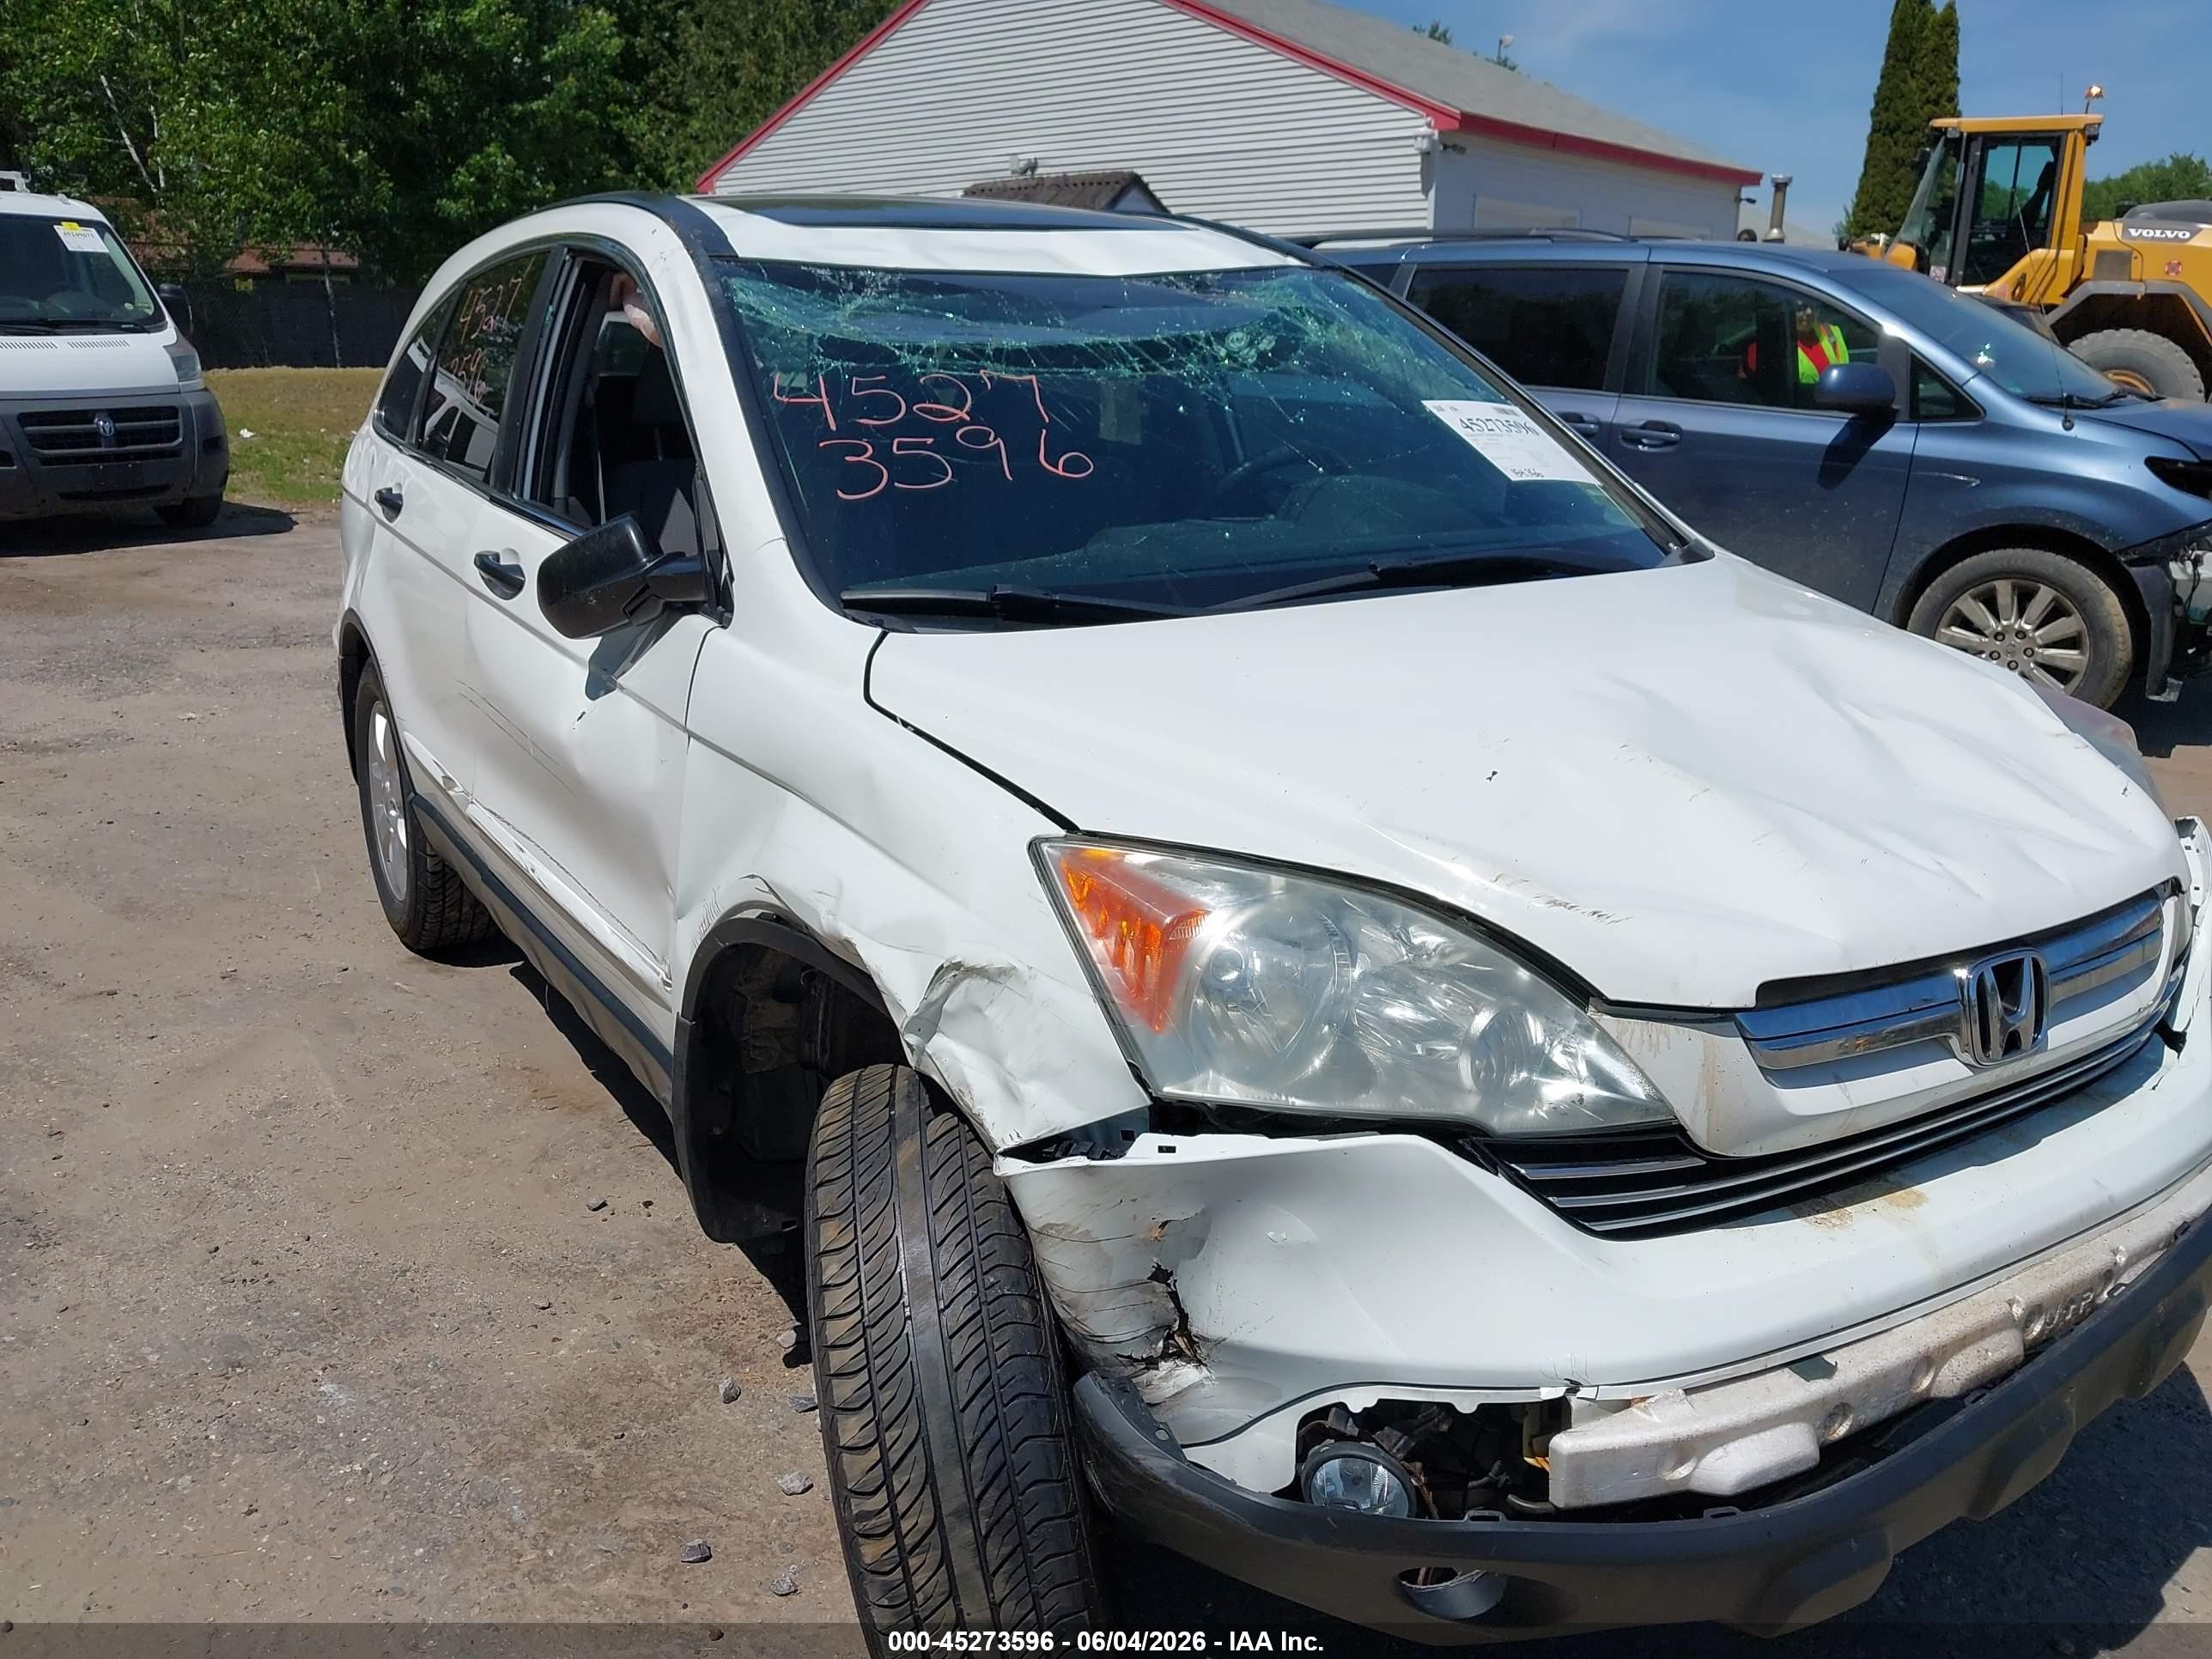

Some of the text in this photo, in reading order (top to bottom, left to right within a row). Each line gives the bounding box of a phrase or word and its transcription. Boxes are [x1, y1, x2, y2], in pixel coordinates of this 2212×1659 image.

[2128, 228, 2191, 239] VOLVO
[773, 369, 1049, 431] 4527
[1458, 416, 1540, 436] 45273596
[818, 425, 1095, 501] 3596
